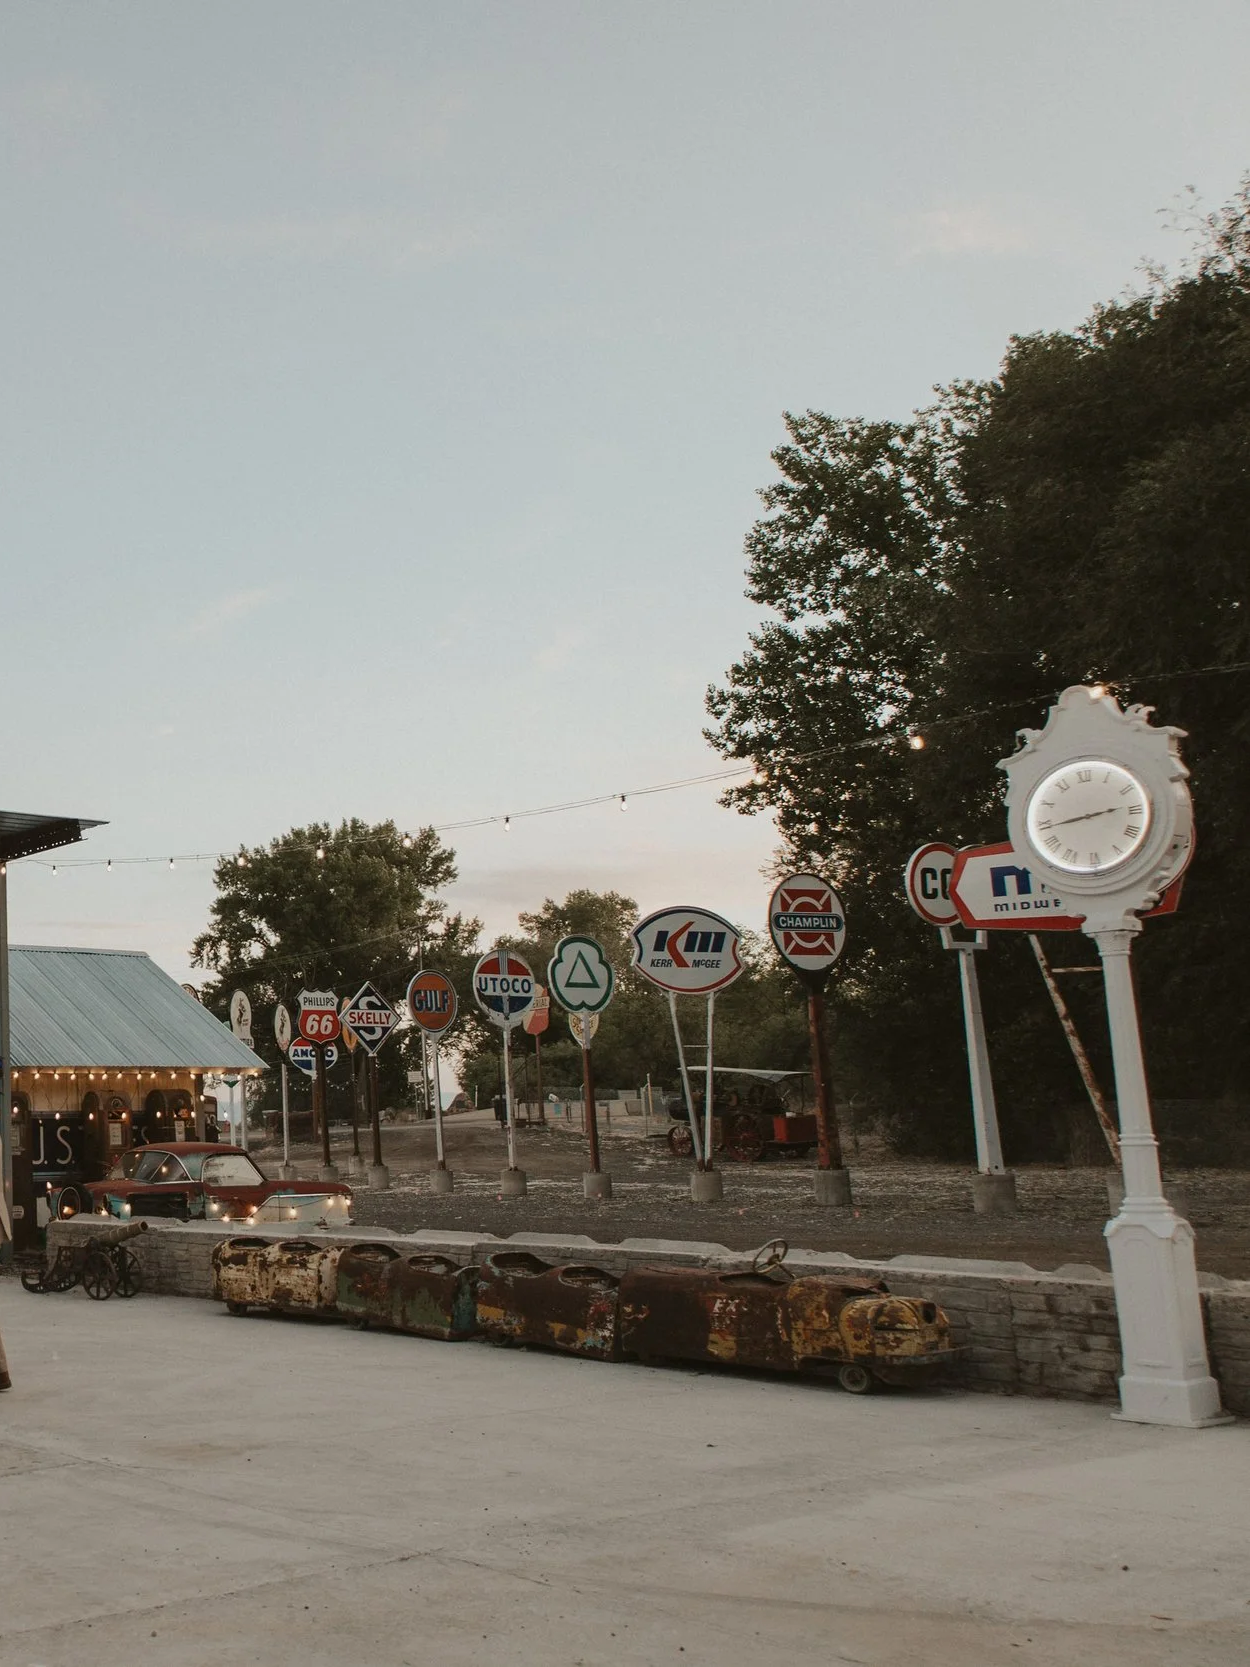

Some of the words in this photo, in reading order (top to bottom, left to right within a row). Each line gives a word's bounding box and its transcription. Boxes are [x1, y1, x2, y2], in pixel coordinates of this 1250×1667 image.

[779, 915, 838, 929] CHAMPLIN
[650, 958, 673, 968] KERR
[478, 976, 532, 994] UTOCO
[303, 997, 335, 1007] PHILLIPS
[413, 989, 449, 1013] GULF
[305, 1013, 333, 1035] 66
[349, 1012, 391, 1025] SKELLY
